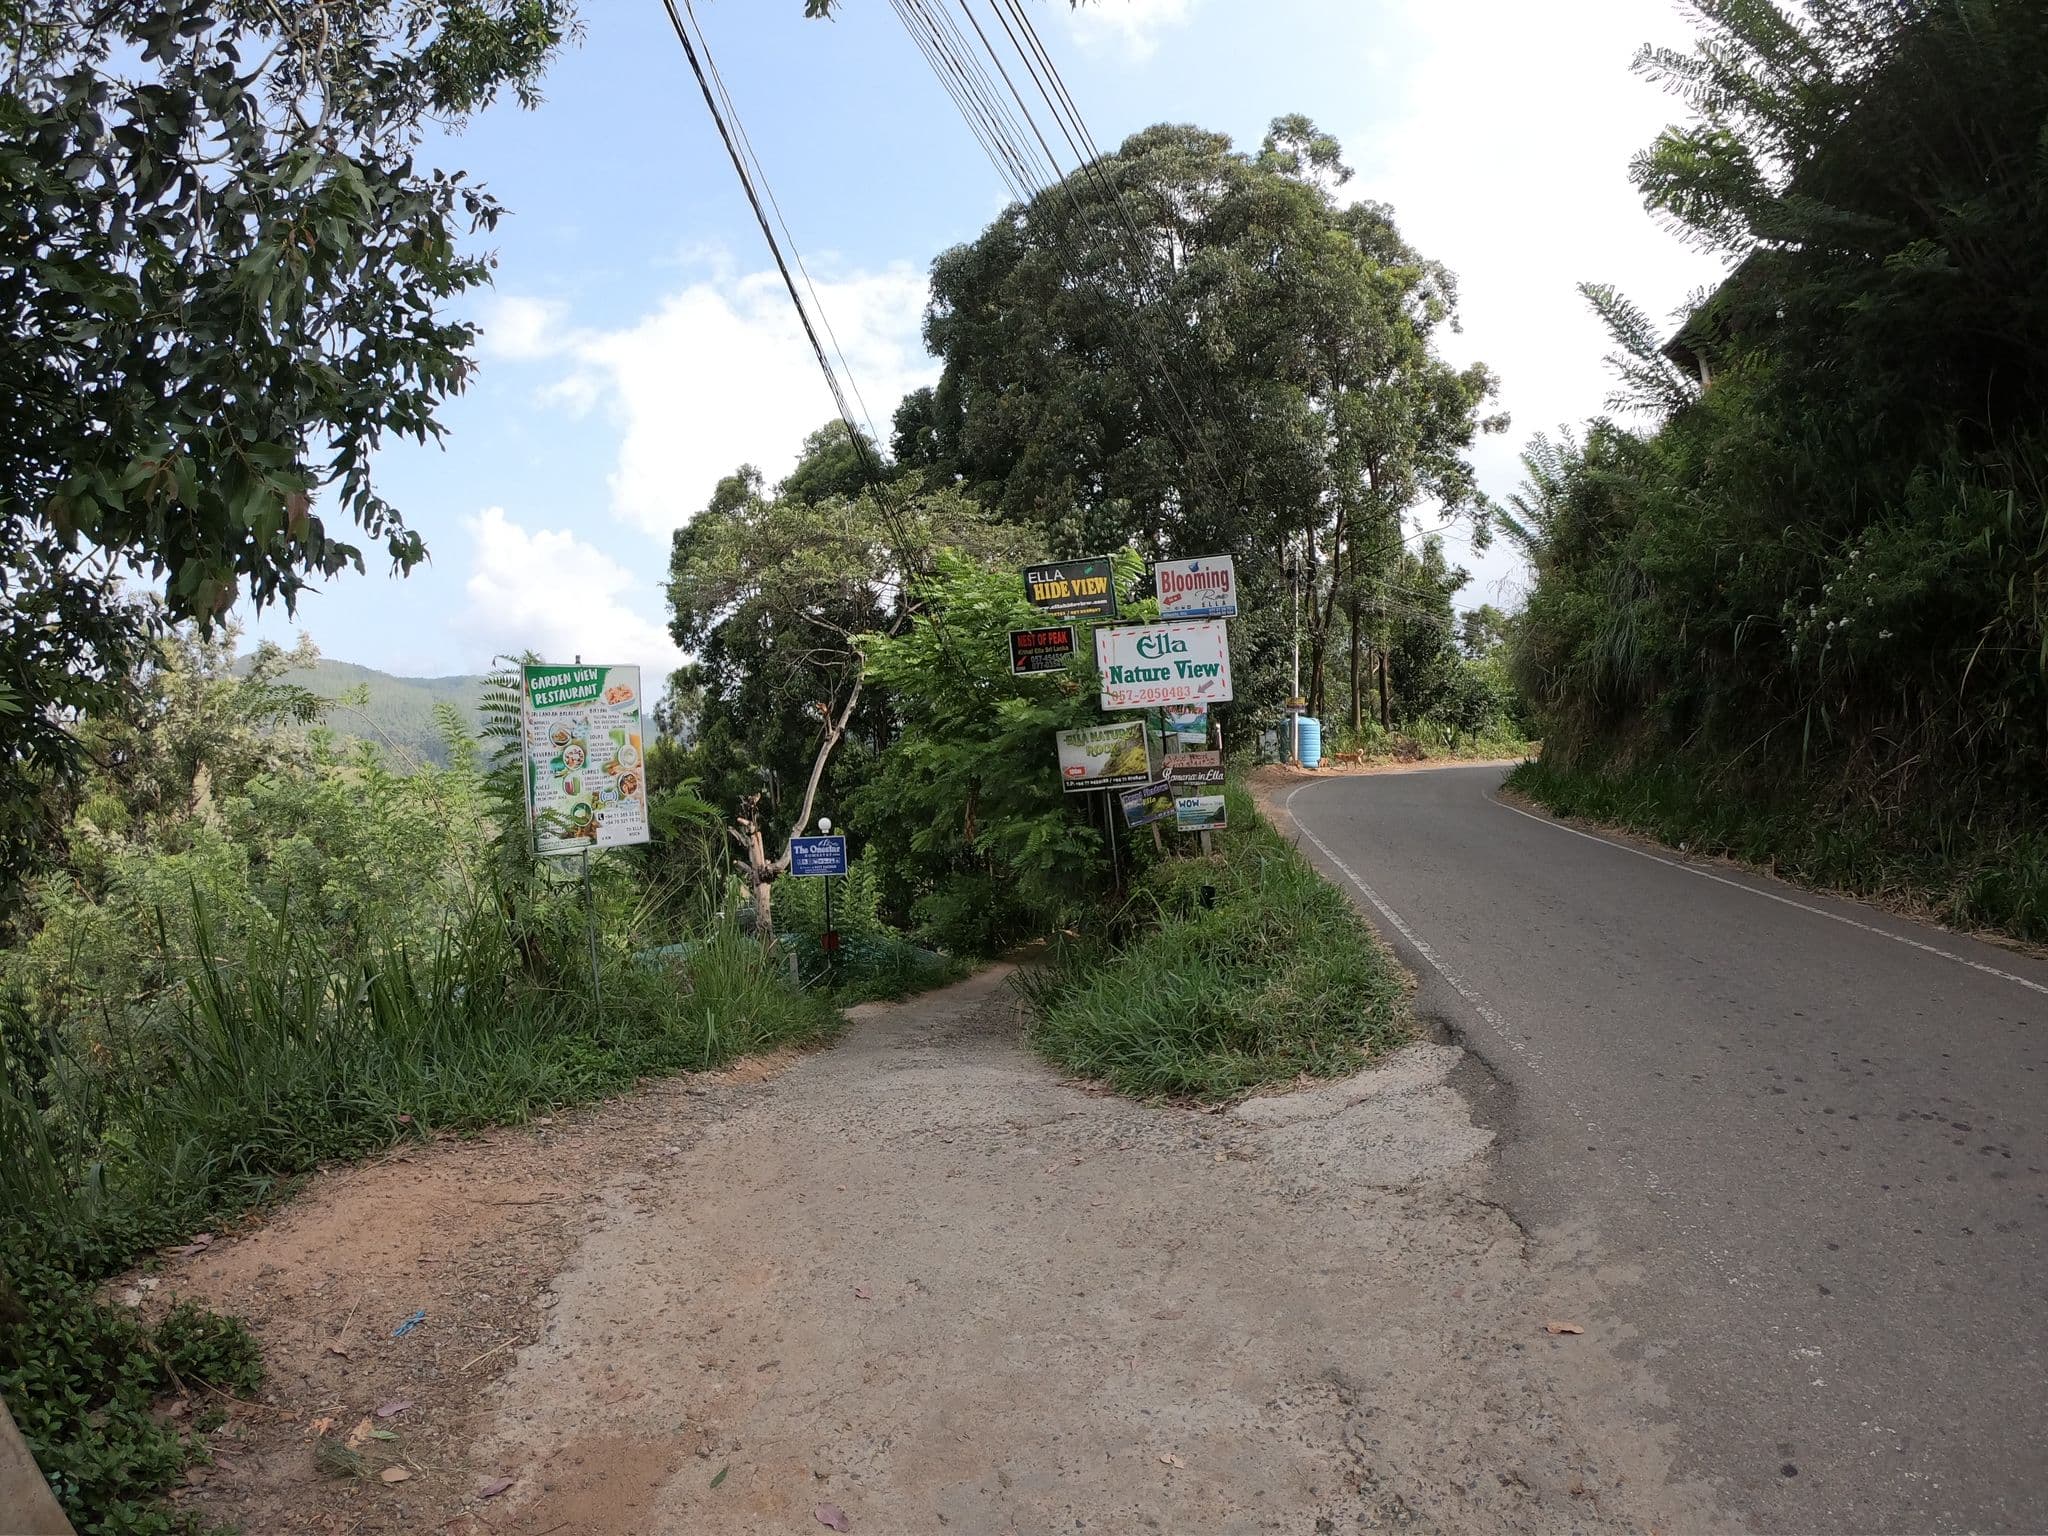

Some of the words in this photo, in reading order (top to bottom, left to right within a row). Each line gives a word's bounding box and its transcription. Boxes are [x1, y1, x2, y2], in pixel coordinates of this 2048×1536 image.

[1028, 570, 1065, 583] ELLA
[1161, 567, 1230, 593] Blooming
[1033, 581, 1070, 600] HIDE
[1071, 577, 1107, 596] VIEW
[1037, 633, 1047, 646] OF
[1048, 631, 1068, 645] PEAK
[1136, 633, 1188, 659] Ella
[531, 673, 571, 690] GARDEN
[574, 668, 598, 683] VIEW
[1109, 664, 1171, 684] Nature
[1174, 660, 1220, 679] View
[535, 683, 598, 706] RESTAURANT
[1112, 686, 1191, 701] 057-2050483
[1085, 742, 1120, 757] ROCK
[1206, 770, 1224, 780] Ella
[794, 845, 809, 854] The
